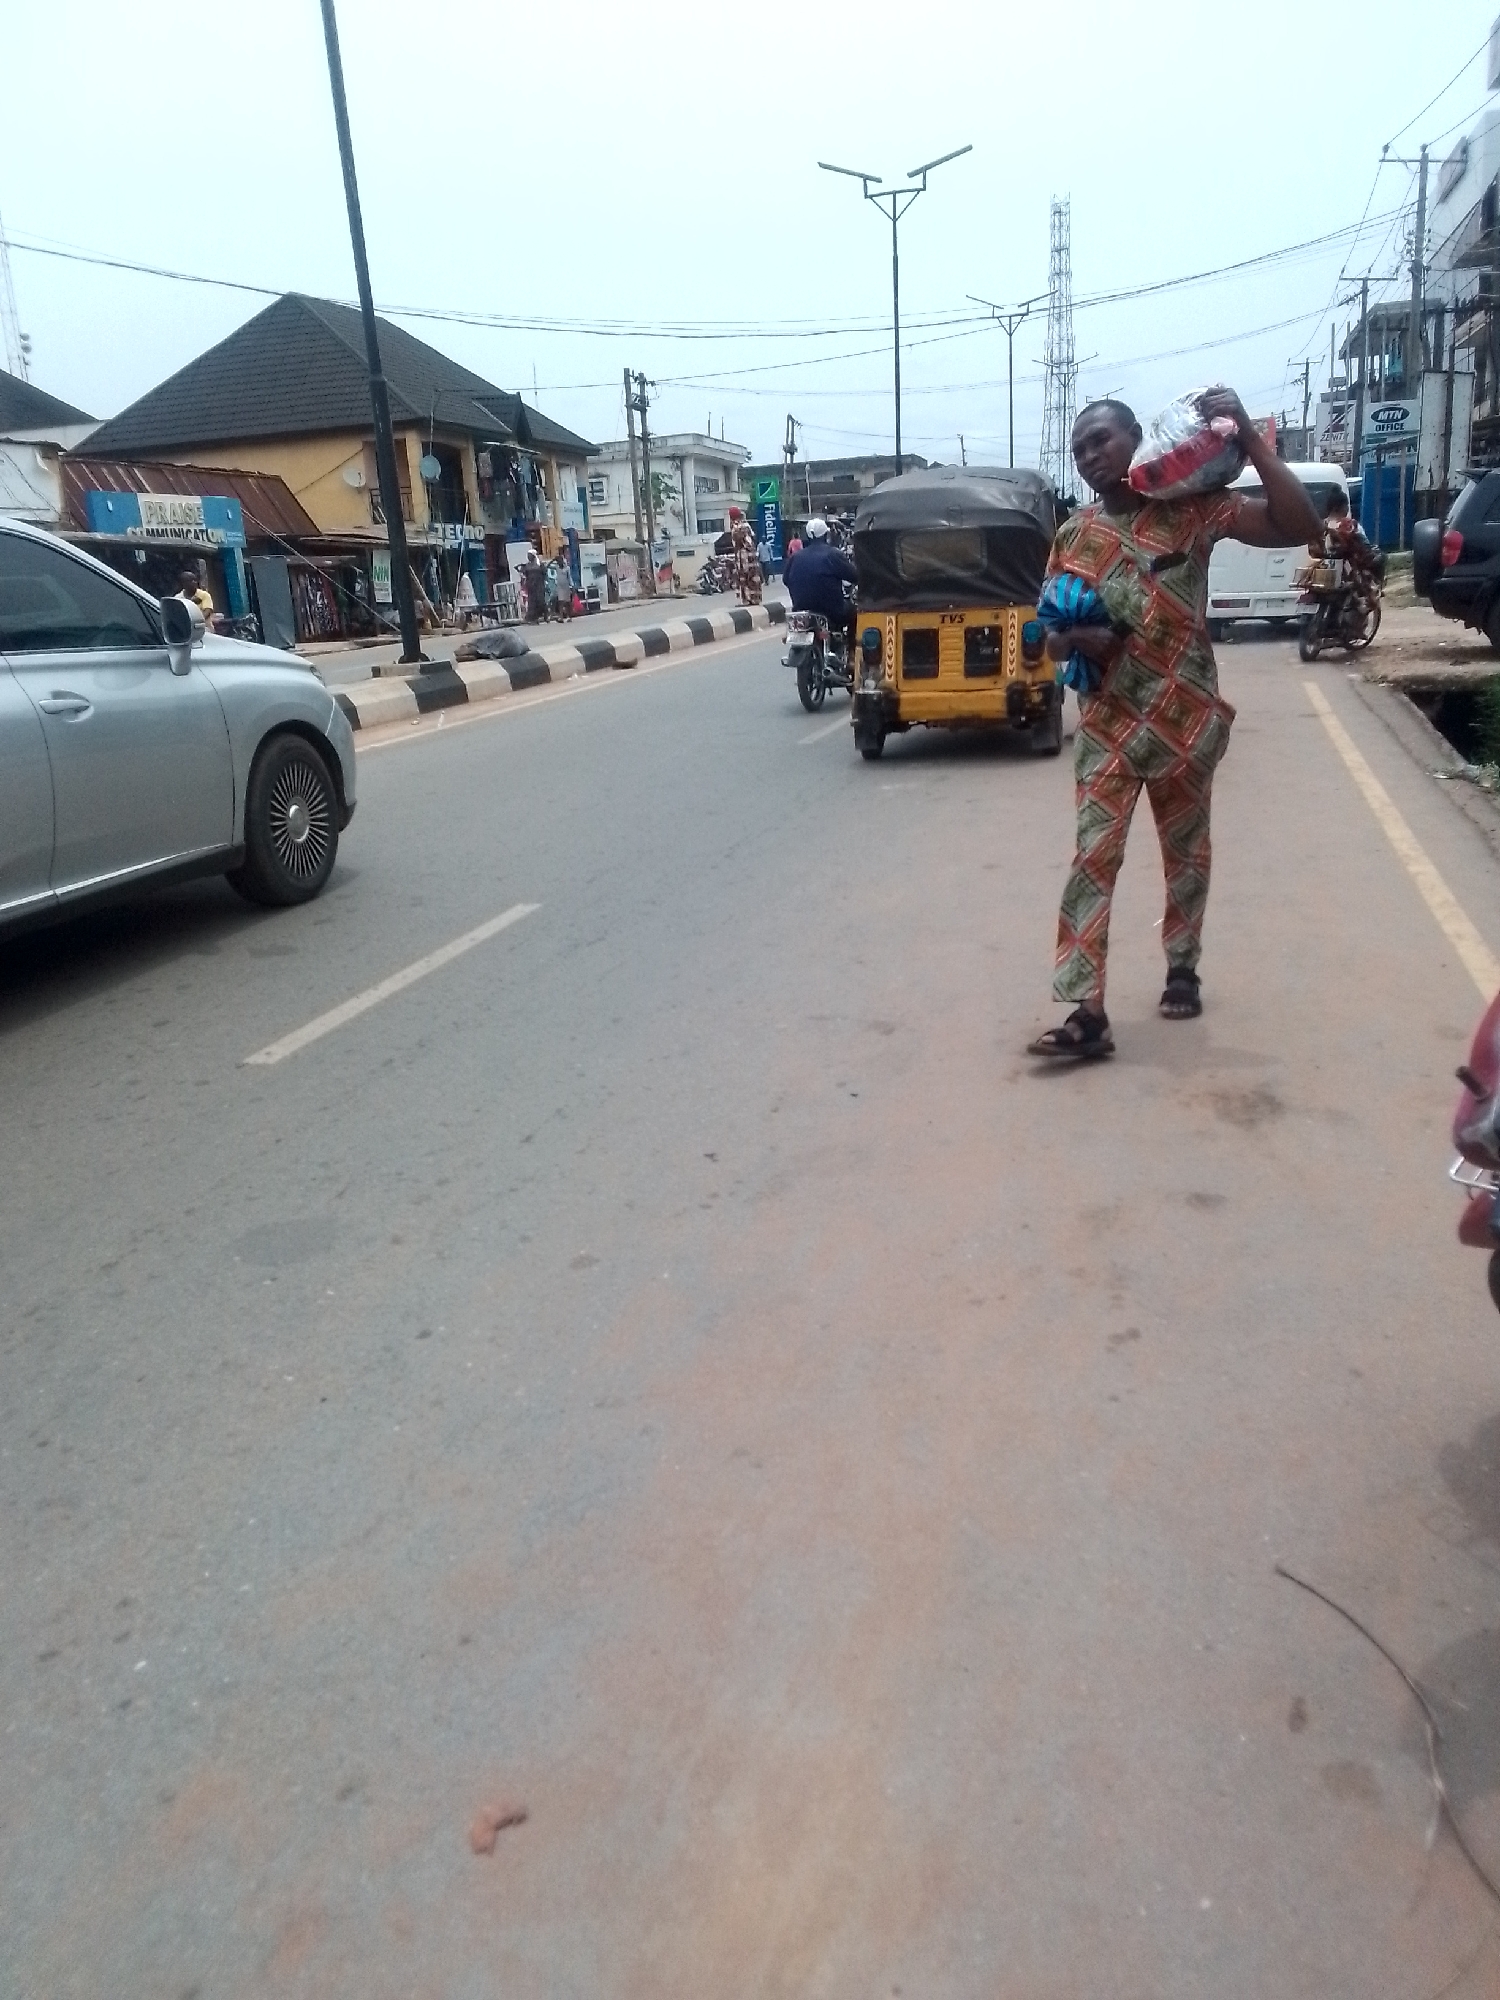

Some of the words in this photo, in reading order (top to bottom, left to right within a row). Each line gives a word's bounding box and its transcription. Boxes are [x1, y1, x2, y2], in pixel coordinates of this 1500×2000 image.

[1377, 409, 1404, 421] MTN
[1375, 422, 1405, 432] OFFICE
[144, 501, 205, 526] PRAISE
[764, 503, 777, 547] Fidelity
[940, 613, 966, 624] TVS
